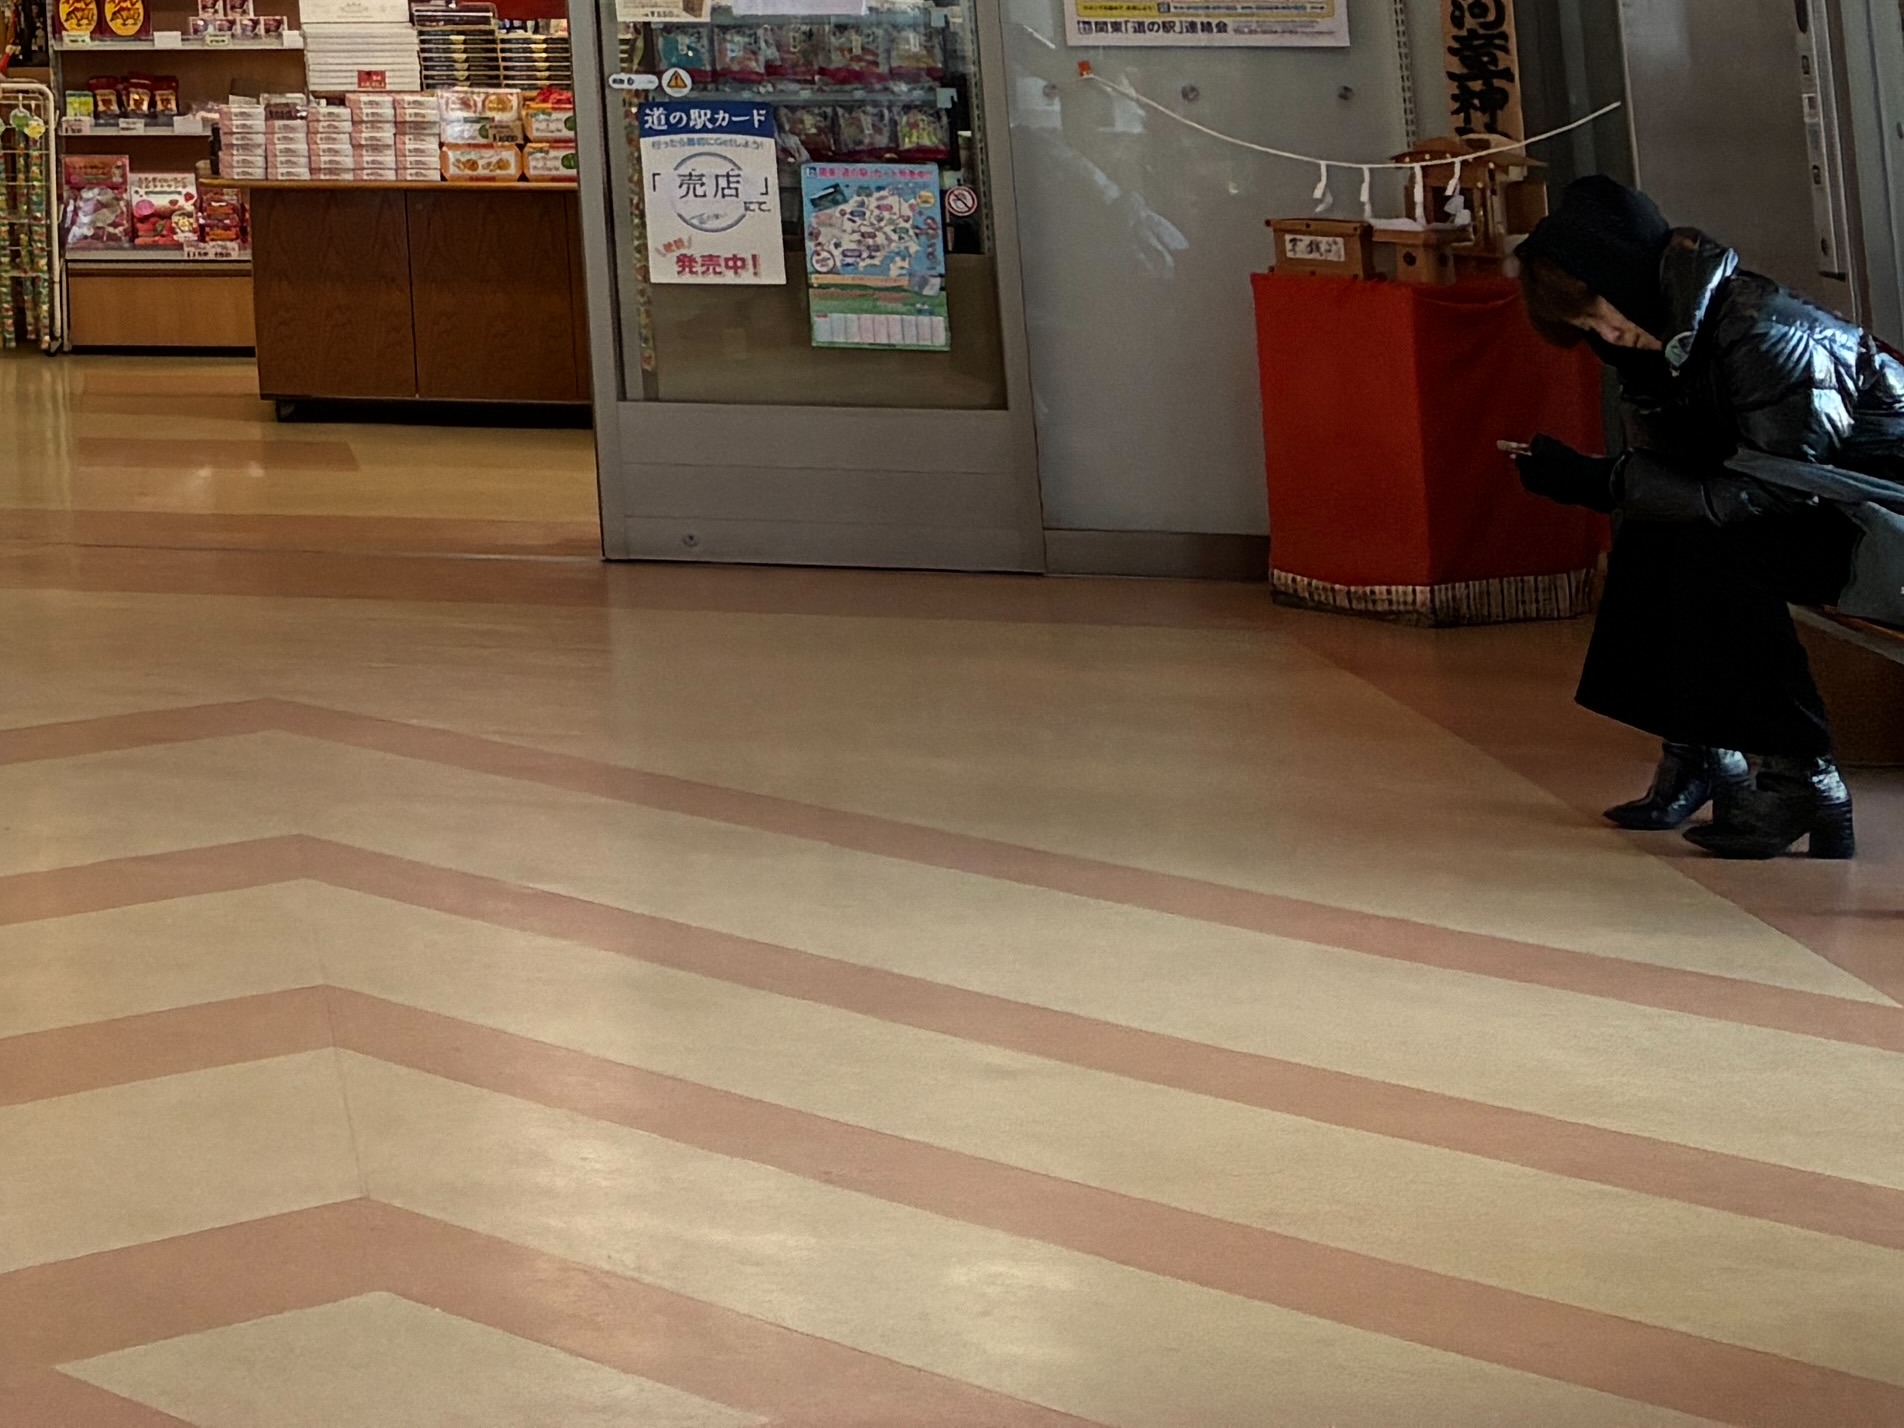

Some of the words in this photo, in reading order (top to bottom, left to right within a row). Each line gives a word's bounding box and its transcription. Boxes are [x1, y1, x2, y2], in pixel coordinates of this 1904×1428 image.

[643, 106, 767, 130] 道の駅カード
